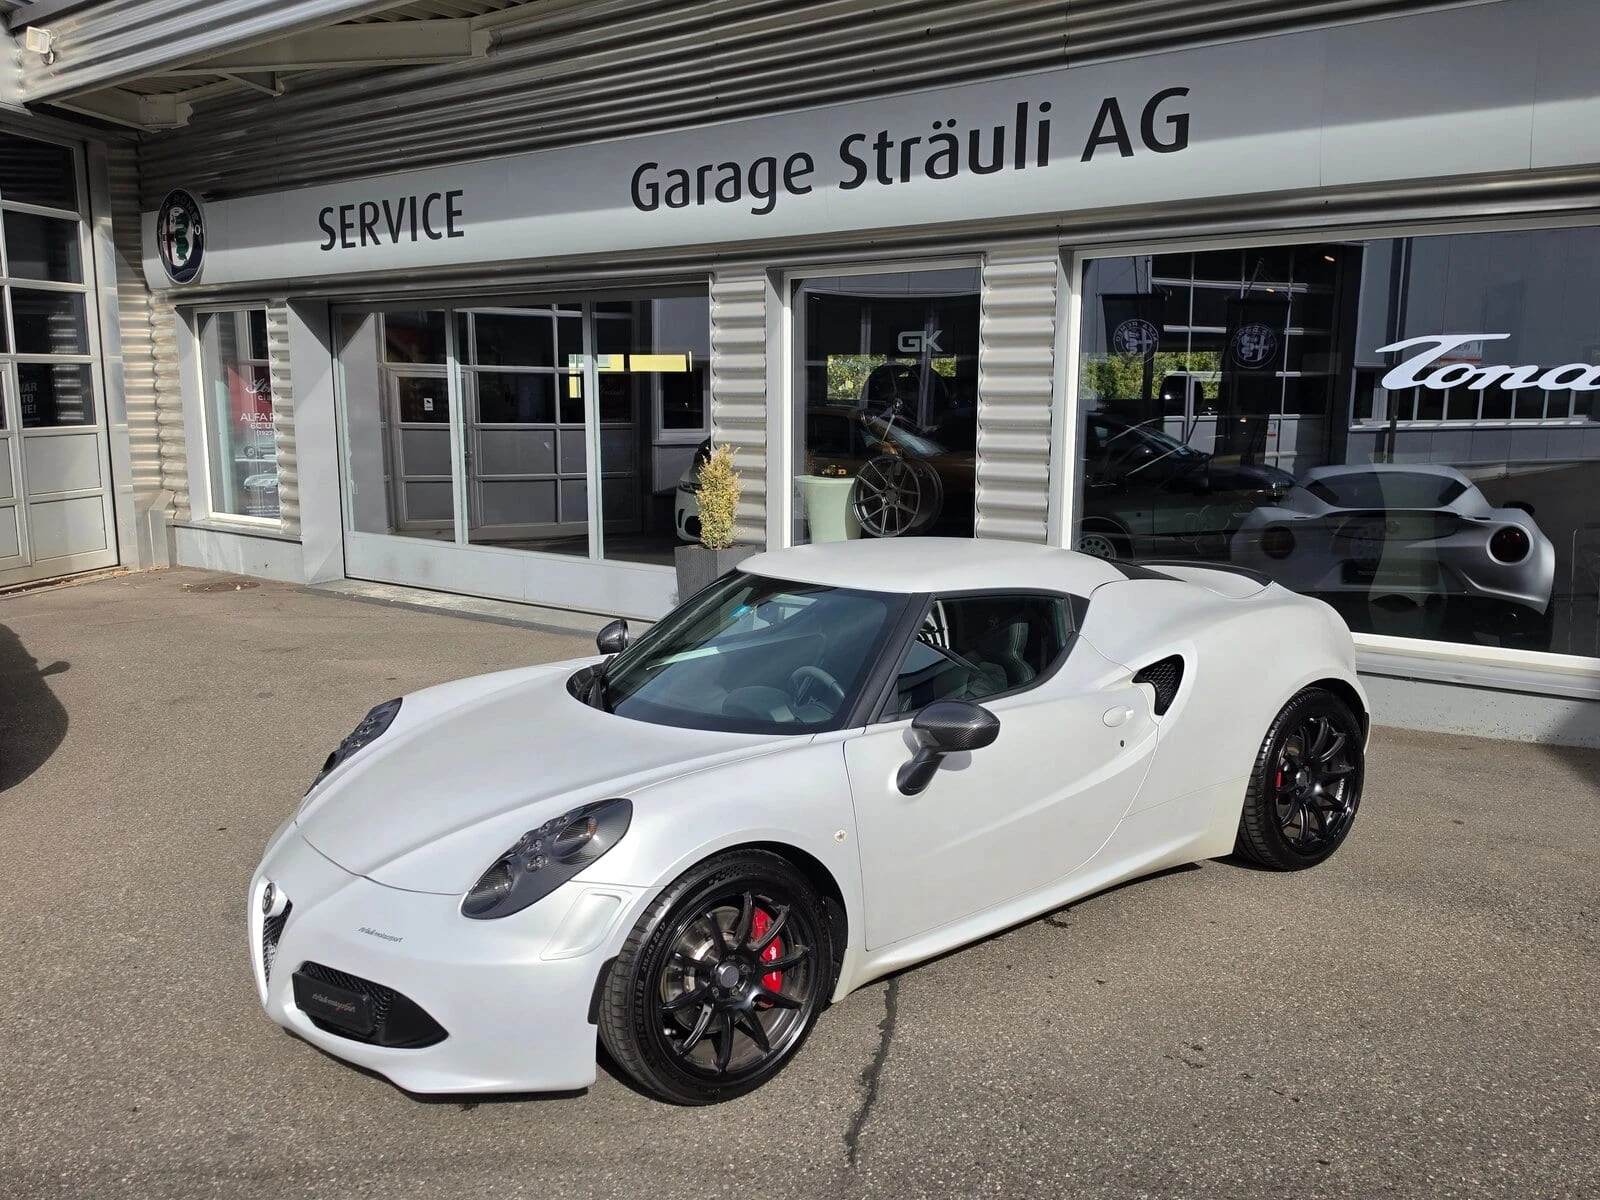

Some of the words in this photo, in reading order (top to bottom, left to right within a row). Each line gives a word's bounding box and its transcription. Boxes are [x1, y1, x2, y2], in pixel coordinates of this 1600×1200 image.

[631, 151, 815, 215] Garage
[839, 101, 1052, 189] Sträuli
[1081, 87, 1191, 162] AG
[319, 190, 465, 252] SERVICE
[897, 329, 944, 353] GK
[240, 412, 268, 422] ALFA
